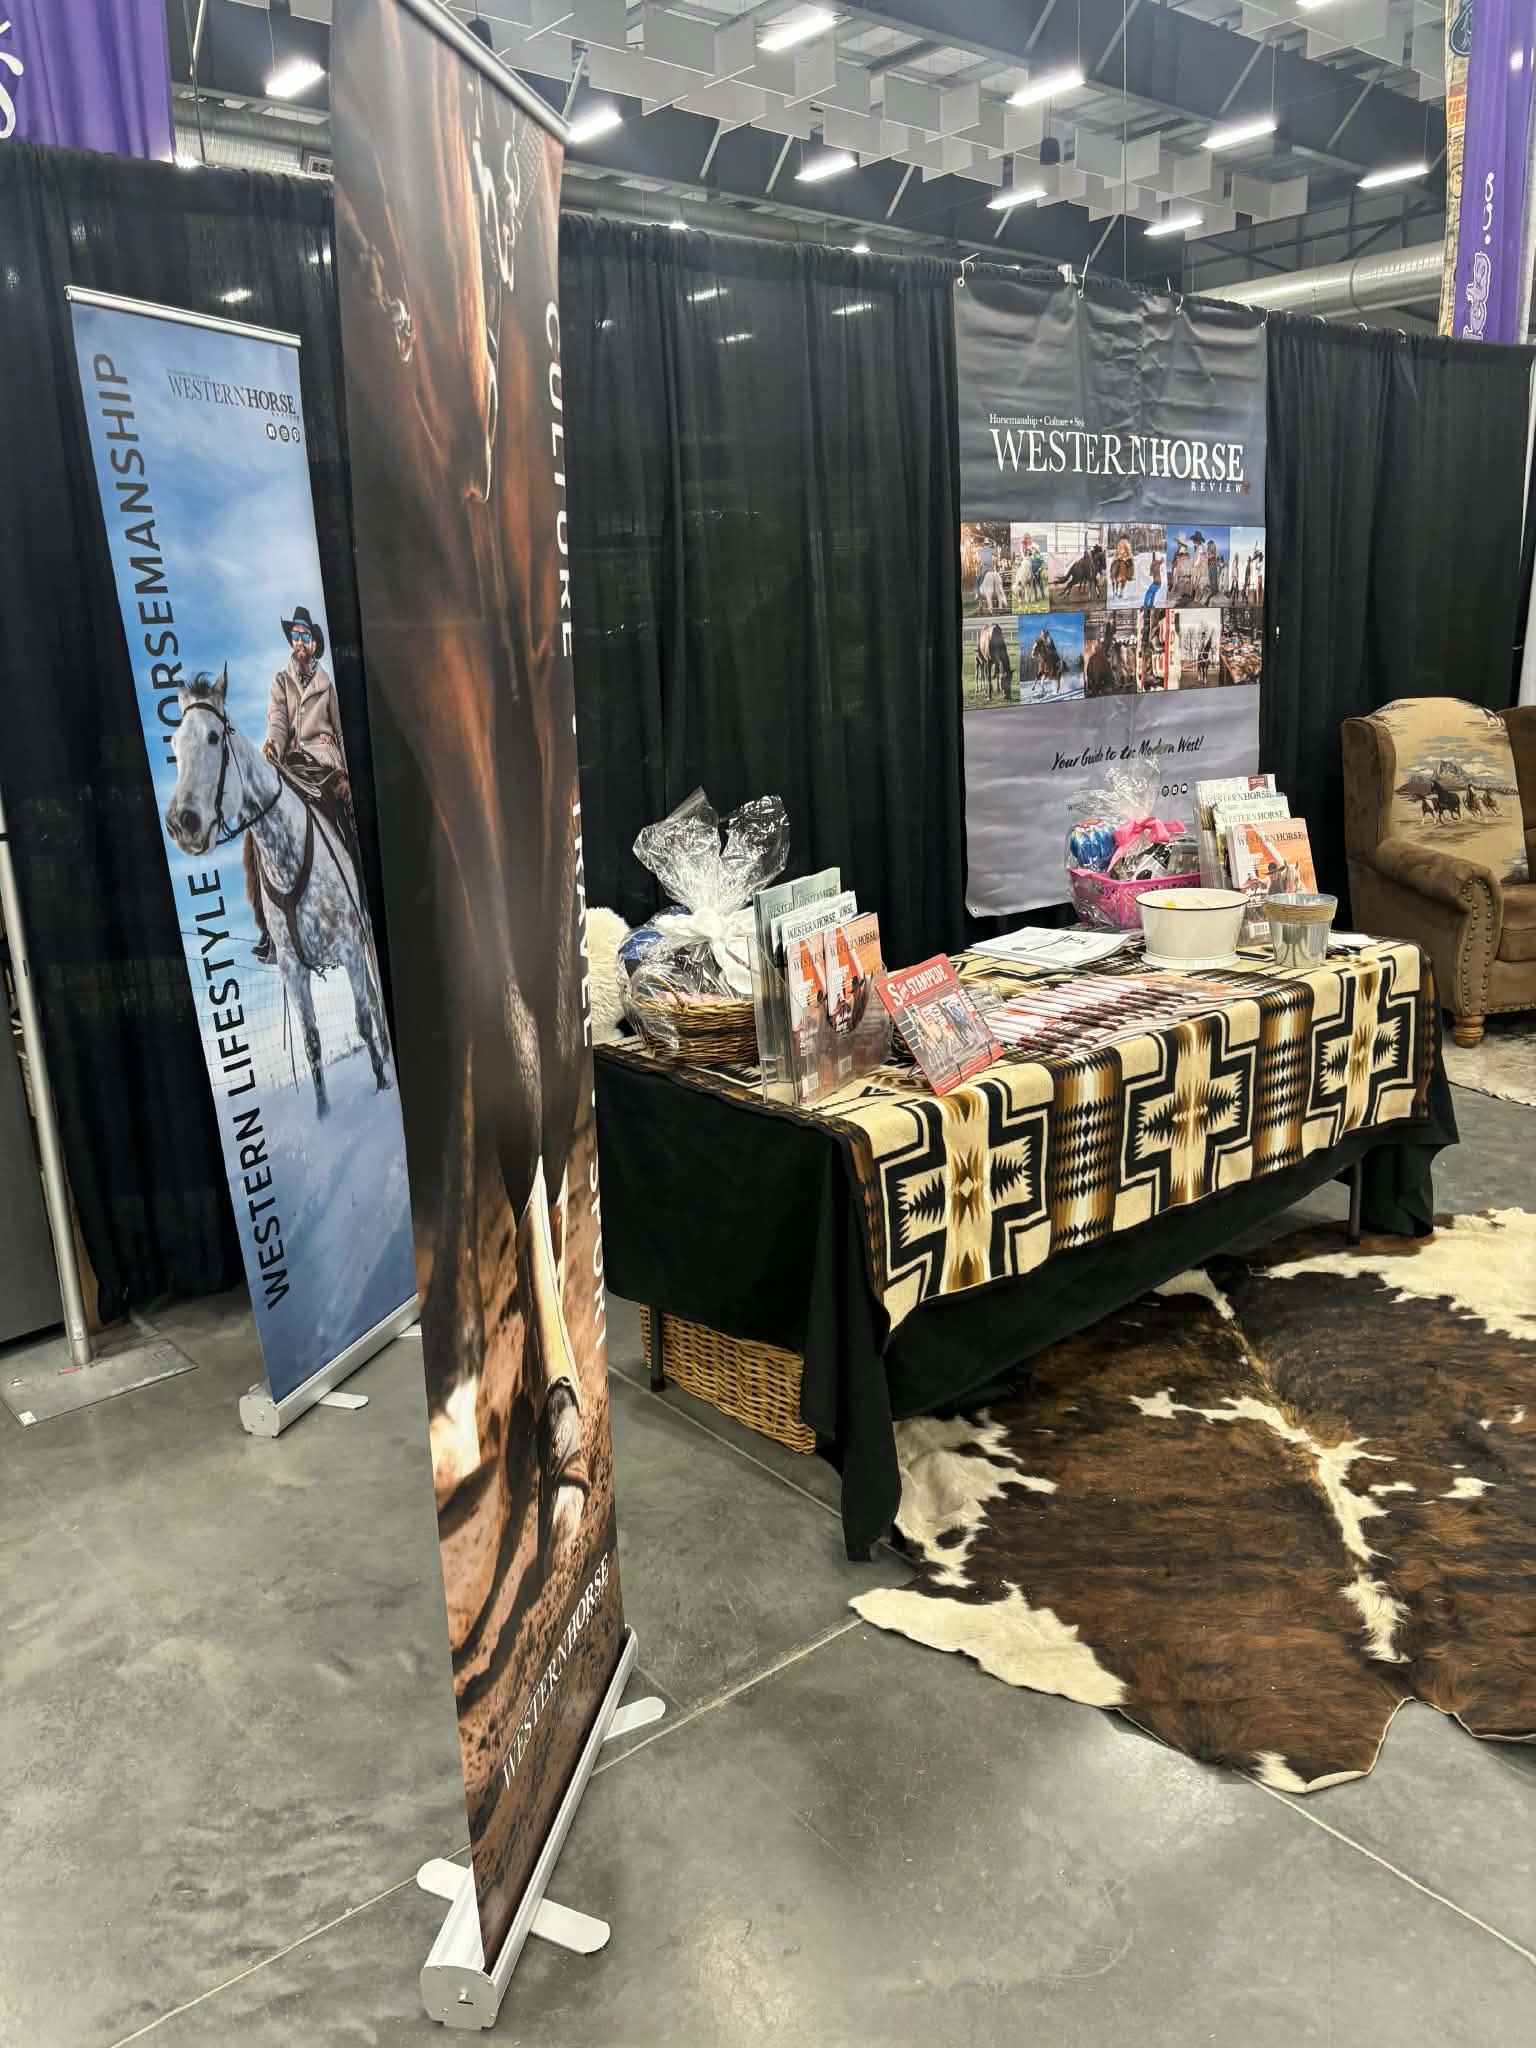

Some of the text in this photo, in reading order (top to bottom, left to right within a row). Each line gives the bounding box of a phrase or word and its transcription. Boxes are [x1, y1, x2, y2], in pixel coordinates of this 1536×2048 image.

[168, 375, 297, 415] WESTERNHORSE
[989, 413, 1038, 428] Horsemanship
[1043, 415, 1069, 426] Culture
[988, 428, 1244, 482] WESTERNHORSE
[1191, 481, 1242, 494] REVIEW
[1051, 752, 1081, 771] Your
[1081, 747, 1103, 767] Guide
[1105, 747, 1117, 761] to
[1177, 735, 1205, 753] West!
[787, 911, 836, 940] WESTERNHORSE
[188, 869, 256, 1097] LIFESTYLE
[905, 963, 949, 996] STAMPEDE
[232, 1107, 290, 1310] WESTERN
[503, 1552, 609, 1790] WESTERNHORSE
